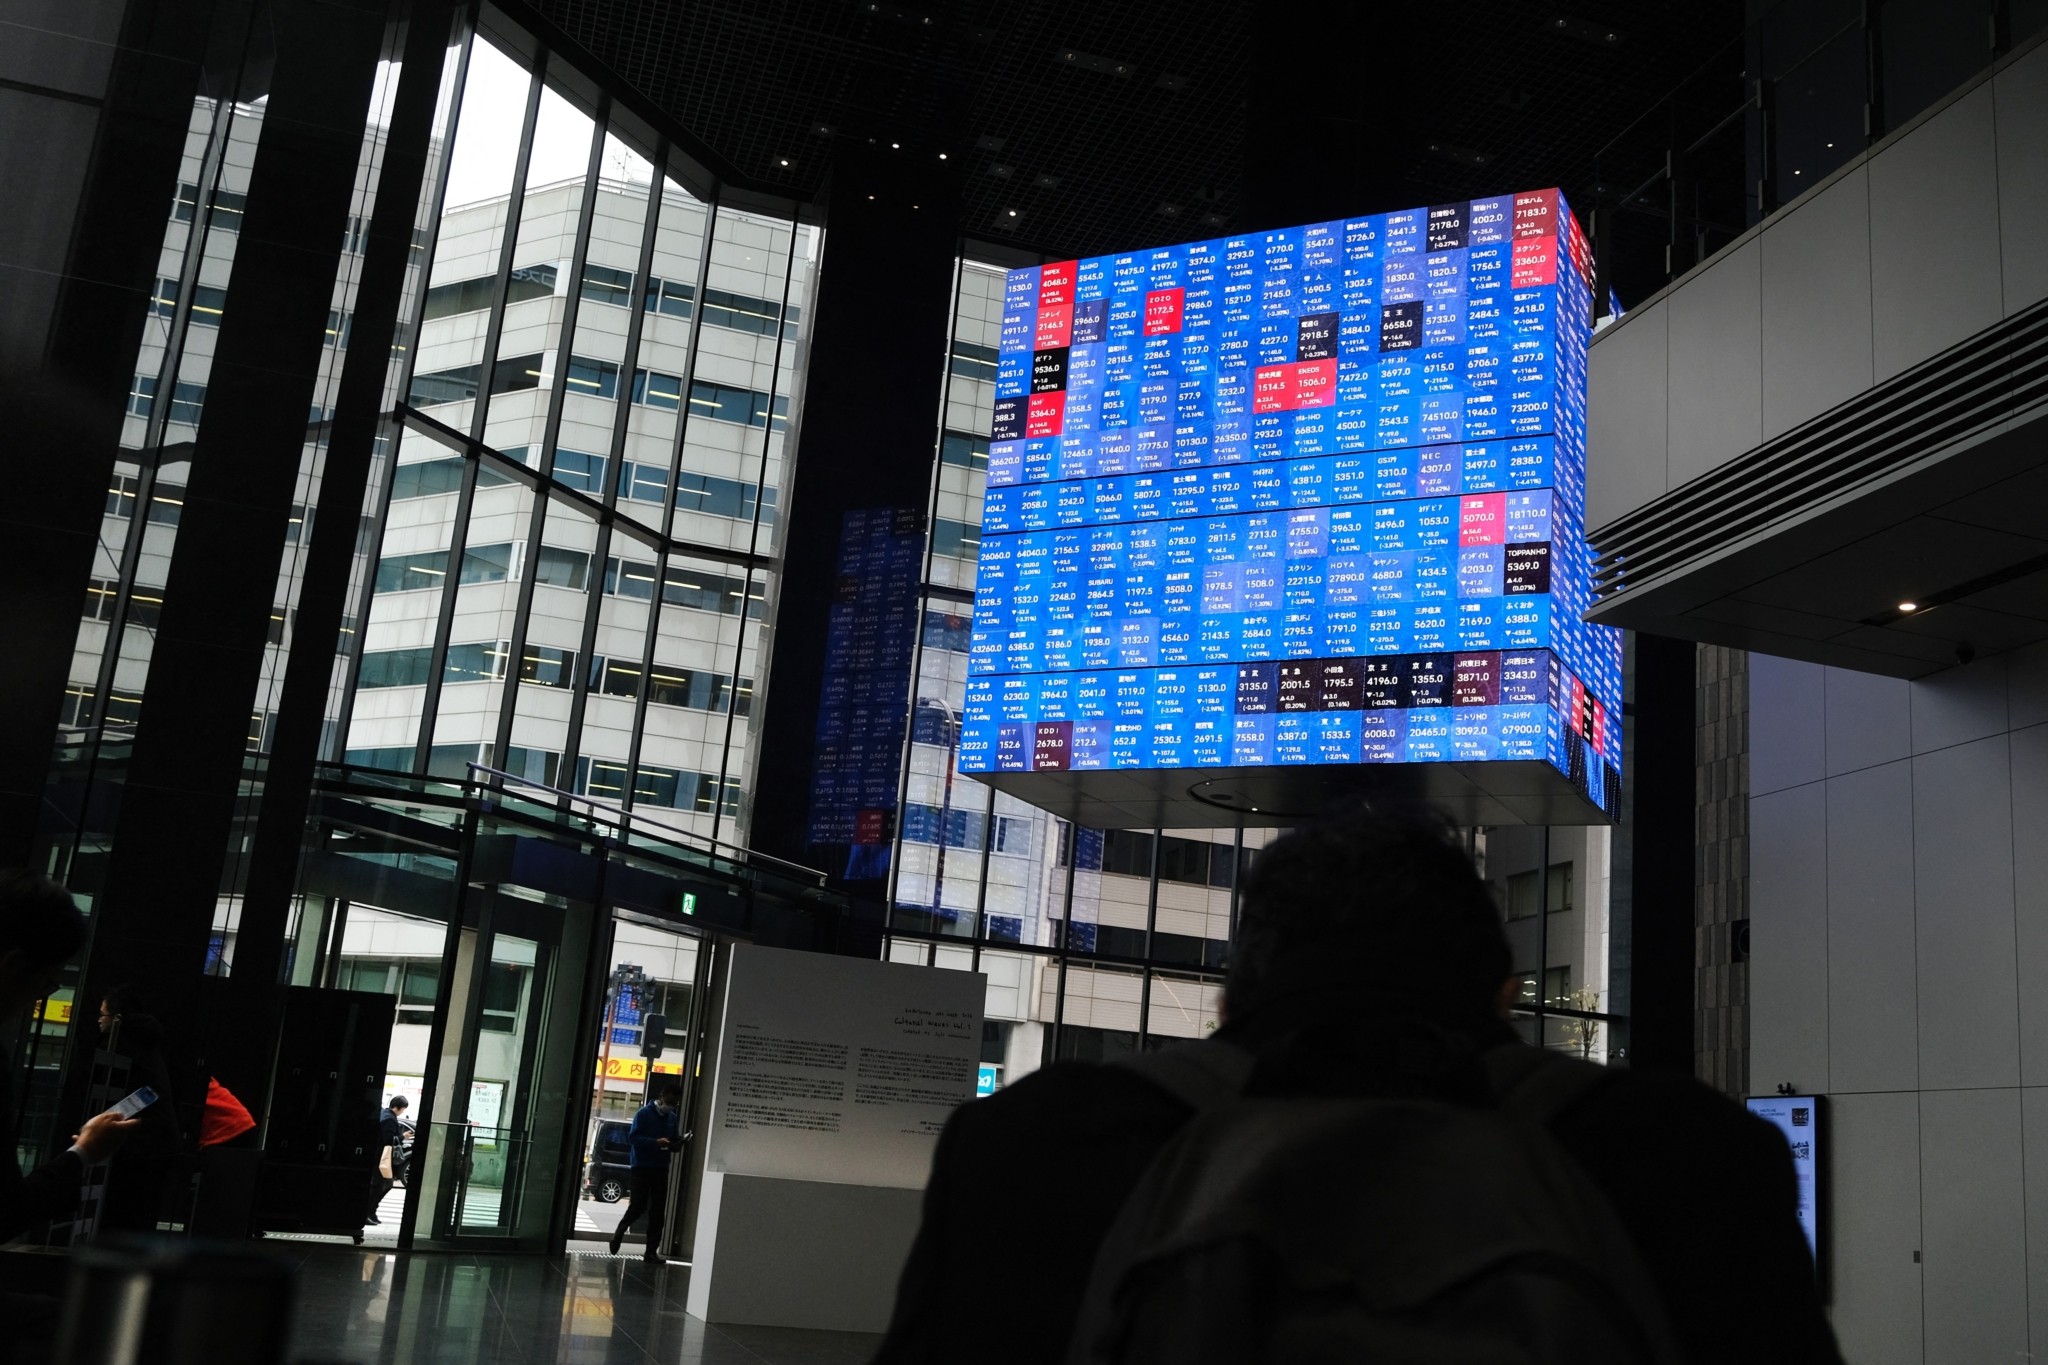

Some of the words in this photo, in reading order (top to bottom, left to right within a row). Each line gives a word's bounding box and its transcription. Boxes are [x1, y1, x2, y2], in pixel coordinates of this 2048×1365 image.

[1472, 213, 1502, 224] 4002.0
[1387, 225, 1416, 236] 2441.5
[1306, 237, 1334, 248] 5547.0
[1227, 249, 1254, 260] 3293.0
[1471, 250, 1497, 258] SUMCO
[1514, 254, 1546, 266] 3360.0
[1151, 261, 1177, 271] 4197.0
[1428, 266, 1457, 276] 1820.5
[1078, 272, 1103, 282] 5545.0
[1008, 282, 1032, 292] 1530.0
[1344, 277, 1372, 288] 1302.5
[1149, 295, 1171, 303] ZOZO
[1263, 289, 1290, 299] 2145.0
[1185, 300, 1212, 310] 2986.0
[1110, 310, 1136, 320] 2505.0
[1469, 308, 1499, 319] 2484.5
[1038, 320, 1063, 330] 2146.5
[1383, 319, 1412, 330] 6658.0
[1300, 330, 1328, 340] 2918.5
[1220, 340, 1248, 350] 2780.0
[1144, 350, 1170, 360] 2286.5
[1512, 352, 1543, 363] 4377.0
[1070, 359, 1096, 369] 6095.0
[1423, 362, 1454, 373] 6715.0
[999, 368, 1024, 378] 3451.0
[1298, 366, 1319, 374] ENEOS
[1339, 372, 1368, 381] 7472.0
[1258, 381, 1285, 391] 1514.5
[1178, 391, 1200, 400] 577.9
[1103, 400, 1124, 409] 805.5
[1030, 408, 1055, 418] 5364.0
[1467, 406, 1497, 416] 1946.0
[1379, 415, 1408, 426] 2543.5
[1294, 424, 1324, 434] 6683.0
[1214, 432, 1247, 443] 26350.0
[1137, 440, 1168, 450] 27775.0
[1063, 448, 1092, 458] 12465.0
[990, 456, 1020, 466] 36620.0
[1510, 455, 1542, 466] 2838.0
[1420, 463, 1451, 473] 4307.0
[1335, 471, 1364, 481] 5351.0
[1252, 478, 1280, 488] 1944.0
[1173, 485, 1205, 495] 13295.0
[1095, 493, 1122, 502] 5066.0
[1021, 500, 1047, 510] 2058.0
[1463, 512, 1494, 522] 5070.0
[1374, 519, 1404, 529] 3496.0
[1289, 526, 1318, 535] 4755.0
[1208, 533, 1236, 542] 2811.5
[1130, 539, 1156, 548] 1538.5
[1053, 545, 1079, 554] 2156.5
[1508, 548, 1547, 556] TOPPANHD
[981, 551, 1010, 560] 26060.0
[1508, 561, 1539, 570] 5369.0
[1417, 567, 1447, 576] 1434.5
[1329, 572, 1364, 582] 27890.0
[1246, 578, 1274, 588] 1508.0
[1165, 584, 1192, 593] 3508.0
[1087, 589, 1114, 599] 2864.5
[1013, 595, 1038, 604] 1532.0
[1370, 621, 1400, 631] 5213.0
[1459, 616, 1491, 626] 2169.0
[1201, 631, 1229, 640] 2143.5
[1284, 626, 1313, 635] 2795.5
[1045, 640, 1072, 649] 5186.0
[1121, 635, 1149, 644] 3132.0
[971, 644, 1002, 652] 43260.0
[1412, 674, 1443, 683] 1355.0
[1504, 670, 1536, 680] 3343.0
[1238, 682, 1268, 690] 3135.0
[1324, 678, 1353, 687] 1795.5
[1079, 688, 1106, 697] 2041.0
[1157, 685, 1185, 694] 4219.0
[1003, 692, 1030, 700] 6230.0
[1277, 731, 1307, 740] 6387.0
[1364, 729, 1395, 738] 6008.0
[1455, 726, 1487, 735] 3092.0
[1036, 739, 1063, 747] 2678.0
[1114, 736, 1136, 745] 652.8
[1194, 734, 1222, 743] 2691.5
[961, 741, 988, 750] 3222.0
